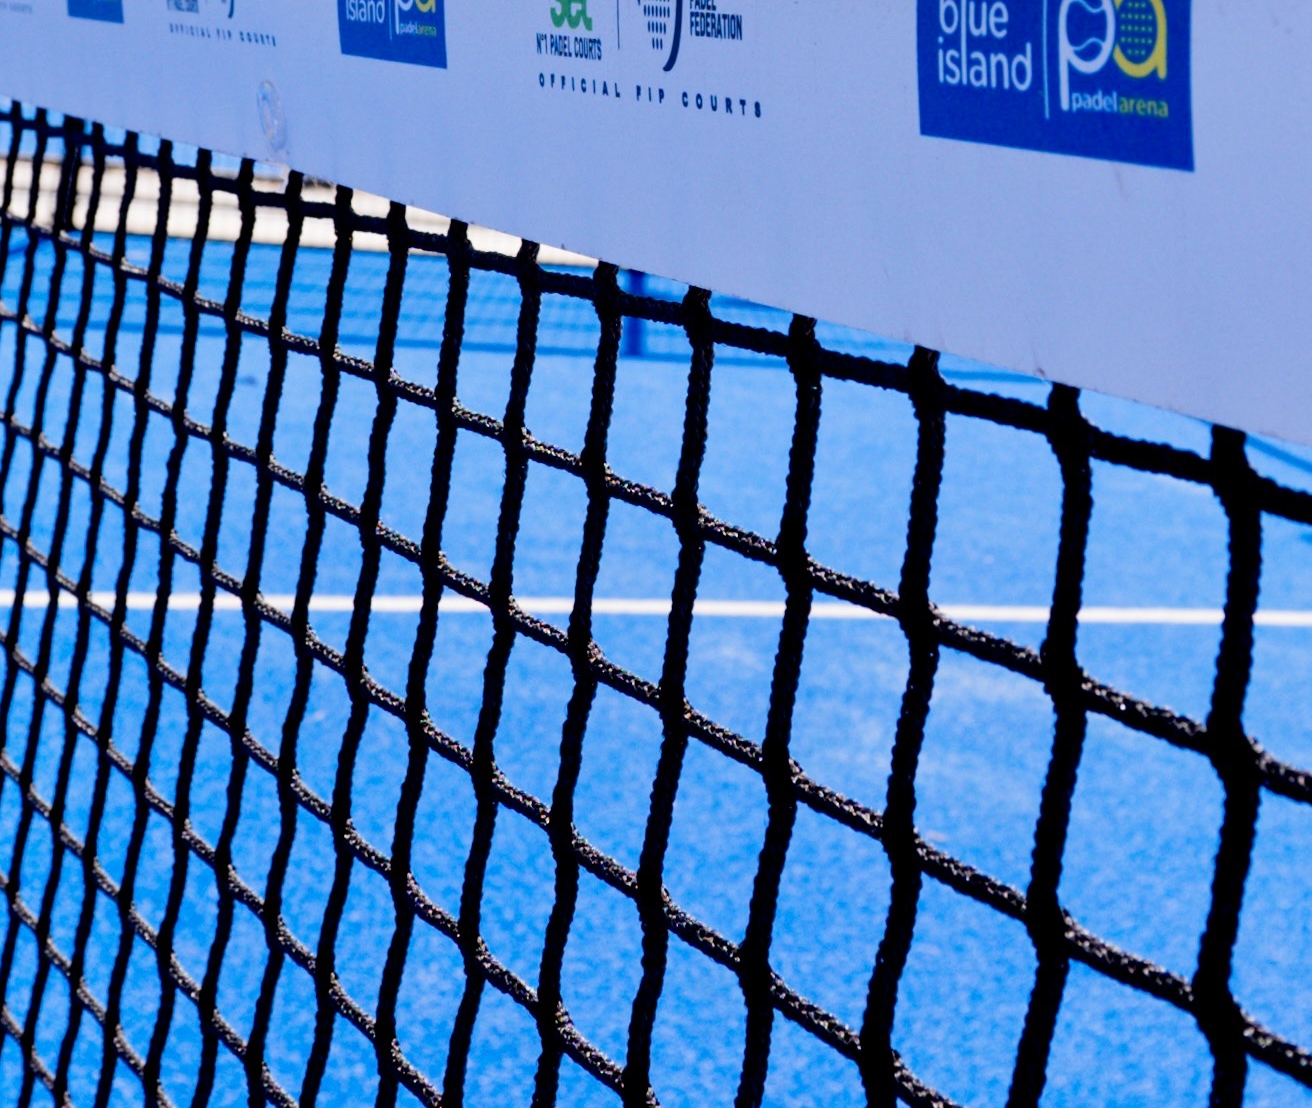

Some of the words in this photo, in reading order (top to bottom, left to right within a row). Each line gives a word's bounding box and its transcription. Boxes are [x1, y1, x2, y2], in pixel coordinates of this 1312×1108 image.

[690, 11, 743, 41] FEDERATION
[550, 33, 572, 58] PADEL
[574, 36, 602, 61] COURTS
[938, 36, 1032, 91] island
[539, 73, 620, 98] OFFICIAL
[636, 85, 665, 104] FIP
[682, 91, 761, 118] COURTS
